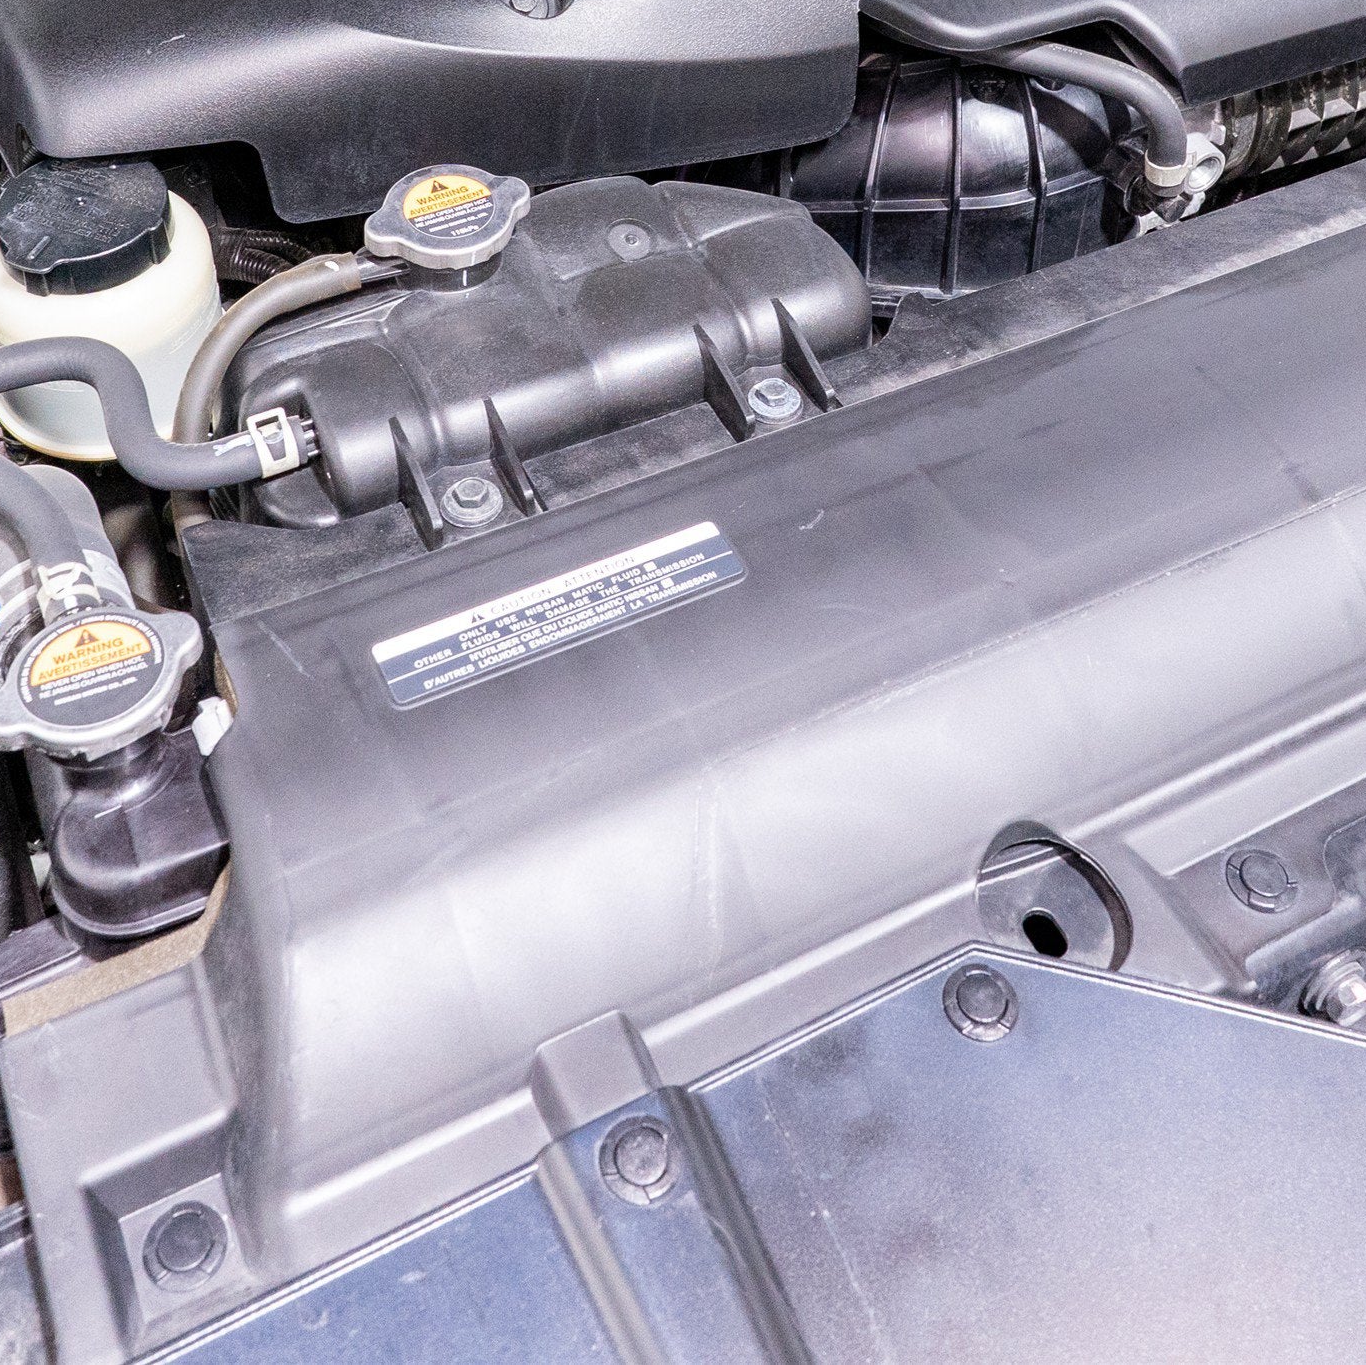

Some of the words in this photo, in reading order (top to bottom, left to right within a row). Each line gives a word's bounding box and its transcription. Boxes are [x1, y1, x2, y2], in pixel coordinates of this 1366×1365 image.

[409, 189, 485, 215] AVERTISSEMENT
[414, 212, 436, 223] NEVER
[436, 207, 455, 217] OPEN
[454, 202, 474, 212] WHEN
[416, 185, 469, 206] WARNING
[490, 587, 552, 615] CAUTION
[563, 555, 636, 588] ATTENTION
[413, 648, 453, 669] OTHER
[461, 630, 502, 651] FLUIDS
[509, 618, 538, 633] WILL
[544, 597, 592, 619] DAMAGE
[598, 585, 621, 599] THE
[627, 552, 706, 587] TRANSMISSION
[458, 625, 488, 642] ONLY
[494, 614, 518, 628] USE
[524, 596, 566, 617] NISSAN
[571, 581, 605, 598] MATIC
[610, 568, 642, 584] FLUID
[468, 637, 521, 662] N'UTILISER
[519, 628, 544, 644] QUE
[542, 621, 559, 635] DU
[558, 609, 596, 628] LIQUIDE
[594, 597, 625, 614] MATIC
[624, 583, 660, 603] NISSAN
[423, 664, 476, 691] D'AUTRES
[478, 645, 527, 670] LIQUIDES
[528, 604, 628, 650] ENDOMMAGERAIENT
[629, 598, 645, 612] LA
[646, 570, 718, 604] TRANSMISSION
[37, 642, 144, 681] AVERTISSEMENT
[51, 636, 124, 666] WARNING
[40, 676, 70, 691] NEVER
[70, 670, 96, 683] OPEN
[95, 663, 123, 676] WHEN
